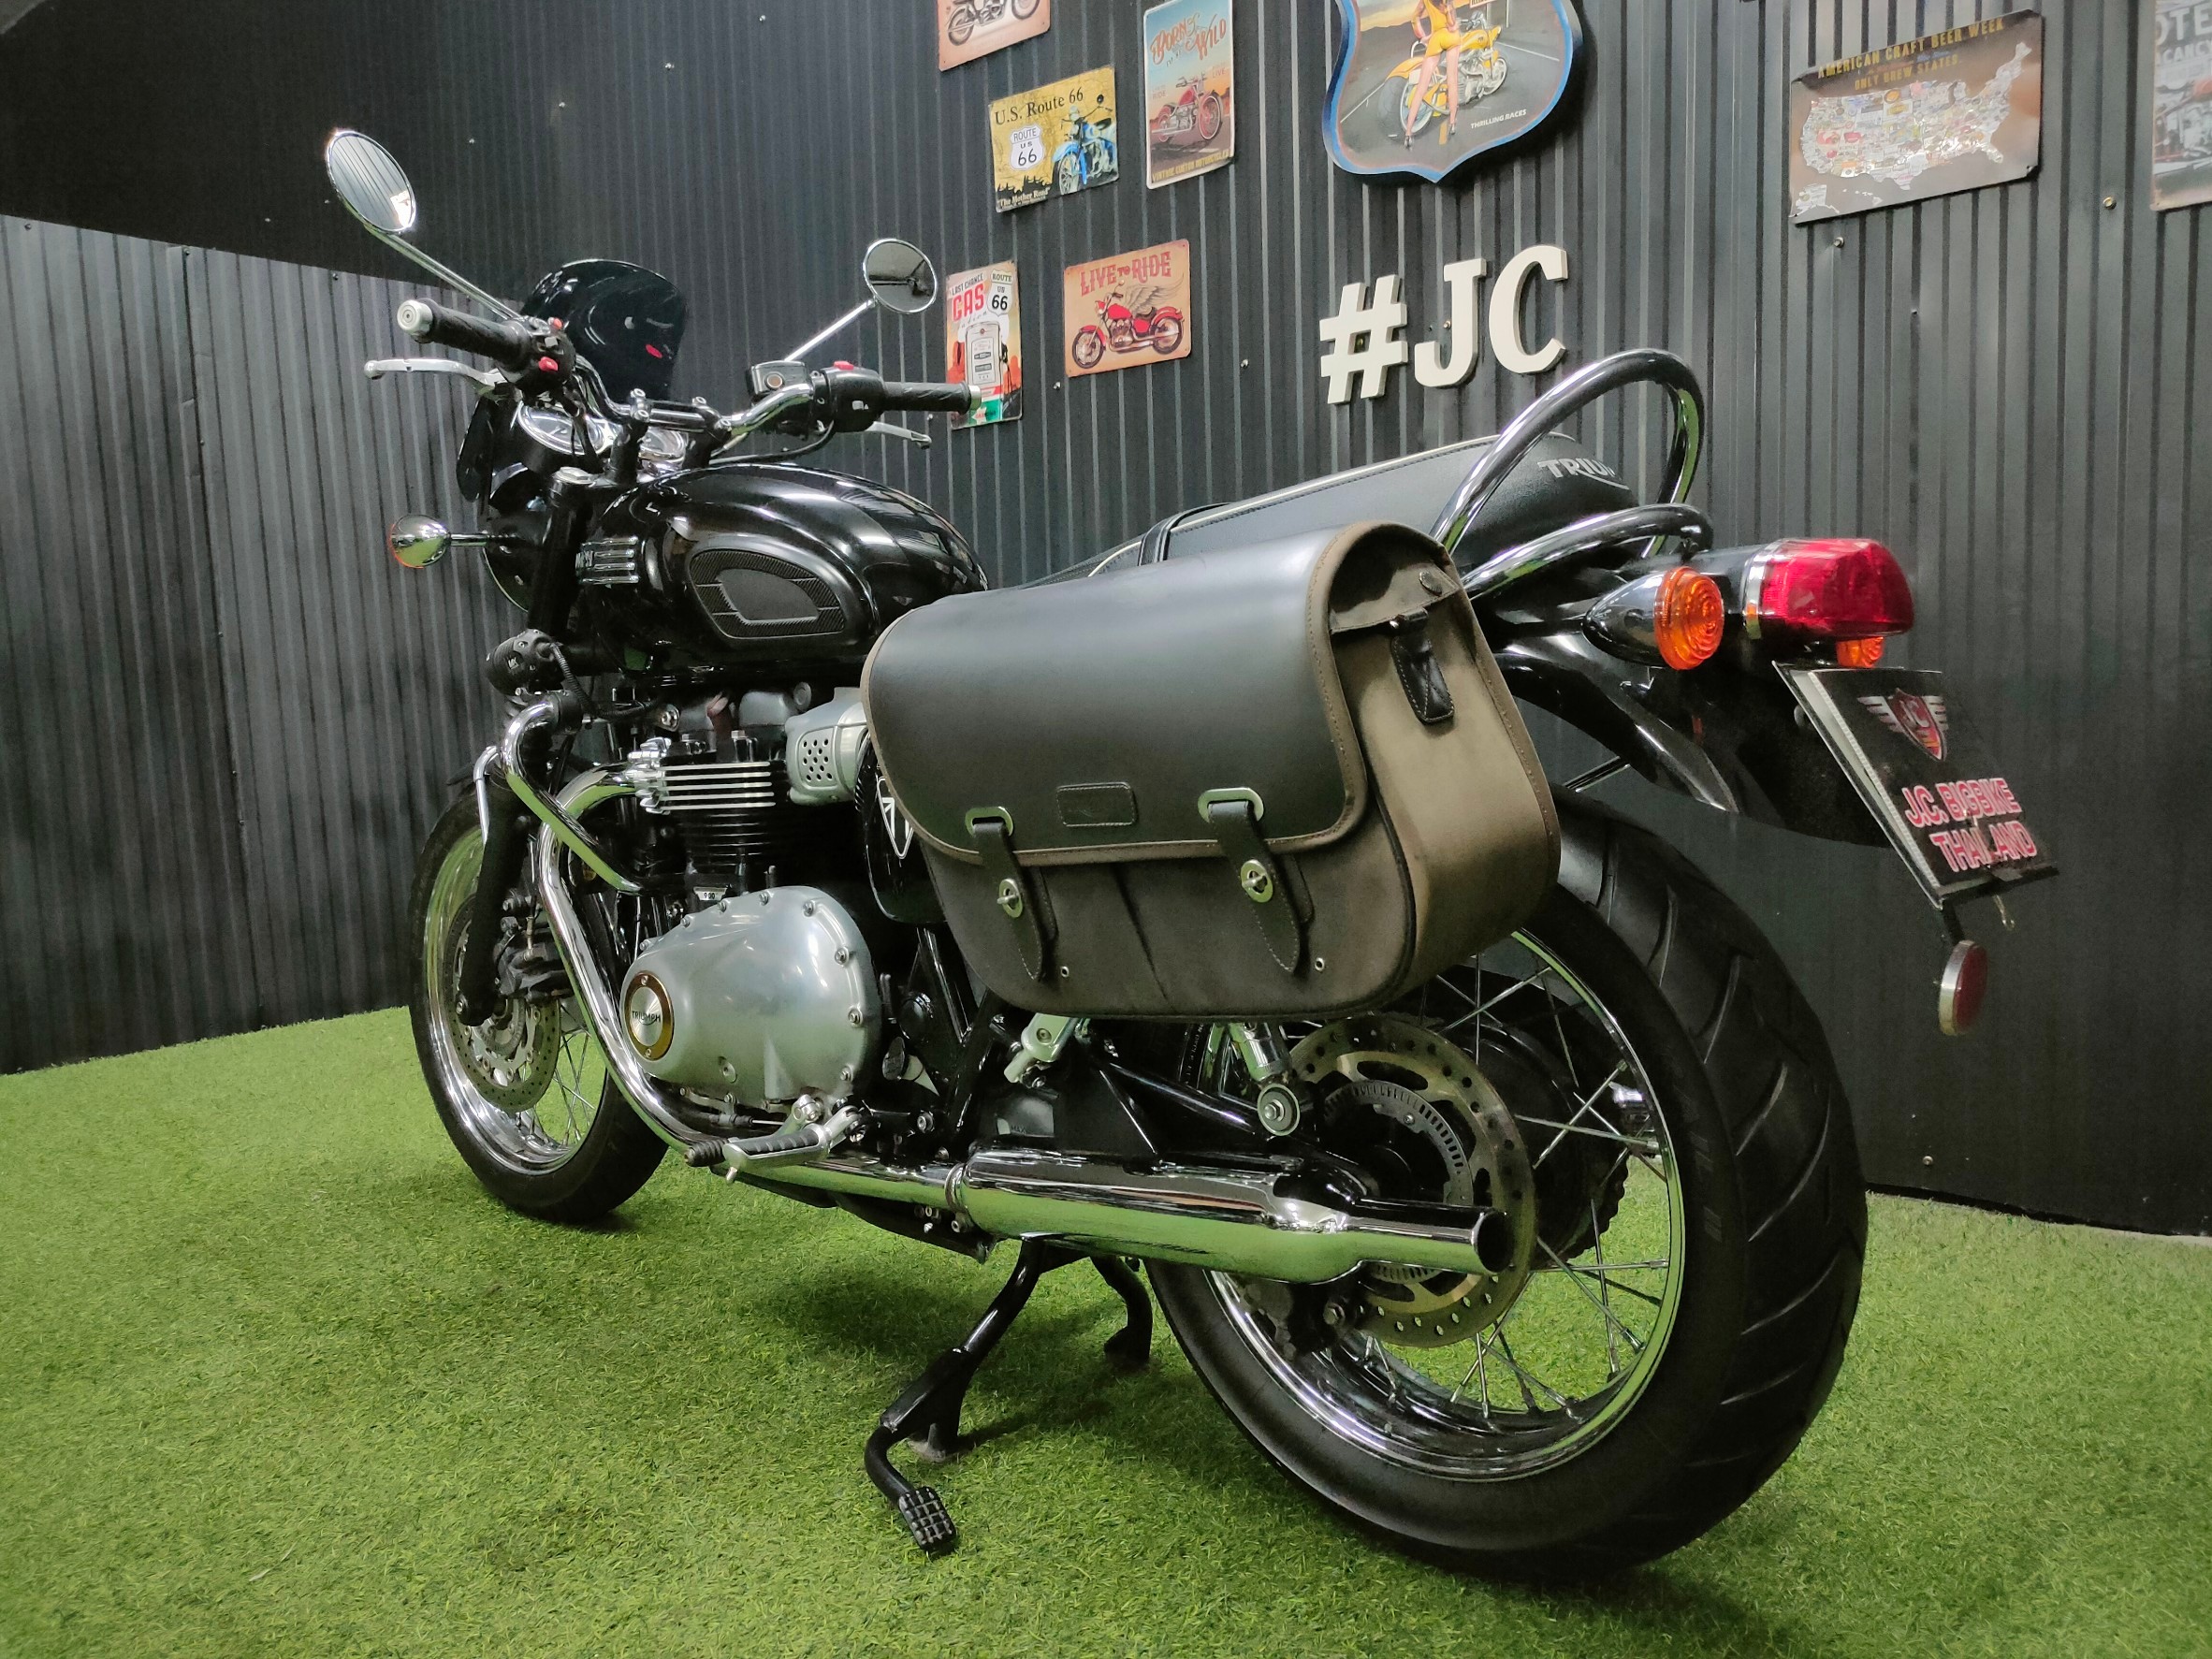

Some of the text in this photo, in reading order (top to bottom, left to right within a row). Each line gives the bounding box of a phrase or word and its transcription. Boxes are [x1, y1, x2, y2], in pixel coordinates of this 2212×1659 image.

[1817, 52, 1880, 79] AMERICAN
[1885, 38, 1925, 61] CRAFT
[1930, 27, 1962, 49] BEER
[1968, 18, 2004, 38] WEEK
[1855, 75, 1880, 91] ONLY
[995, 86, 1084, 125] U.S. Route 66
[1470, 109, 1527, 129] THRILLING RACES
[1013, 128, 1037, 142] ROUTE
[1017, 148, 1038, 167] 66
[992, 273, 1012, 283] ROUTE
[1080, 264, 1117, 297] LIVE
[1131, 251, 1171, 284] RIDE
[952, 273, 983, 296] LAST CHANCE
[953, 283, 984, 322] GAS
[991, 294, 1009, 311] 66
[632, 1011, 661, 1026] TRIUMPH
